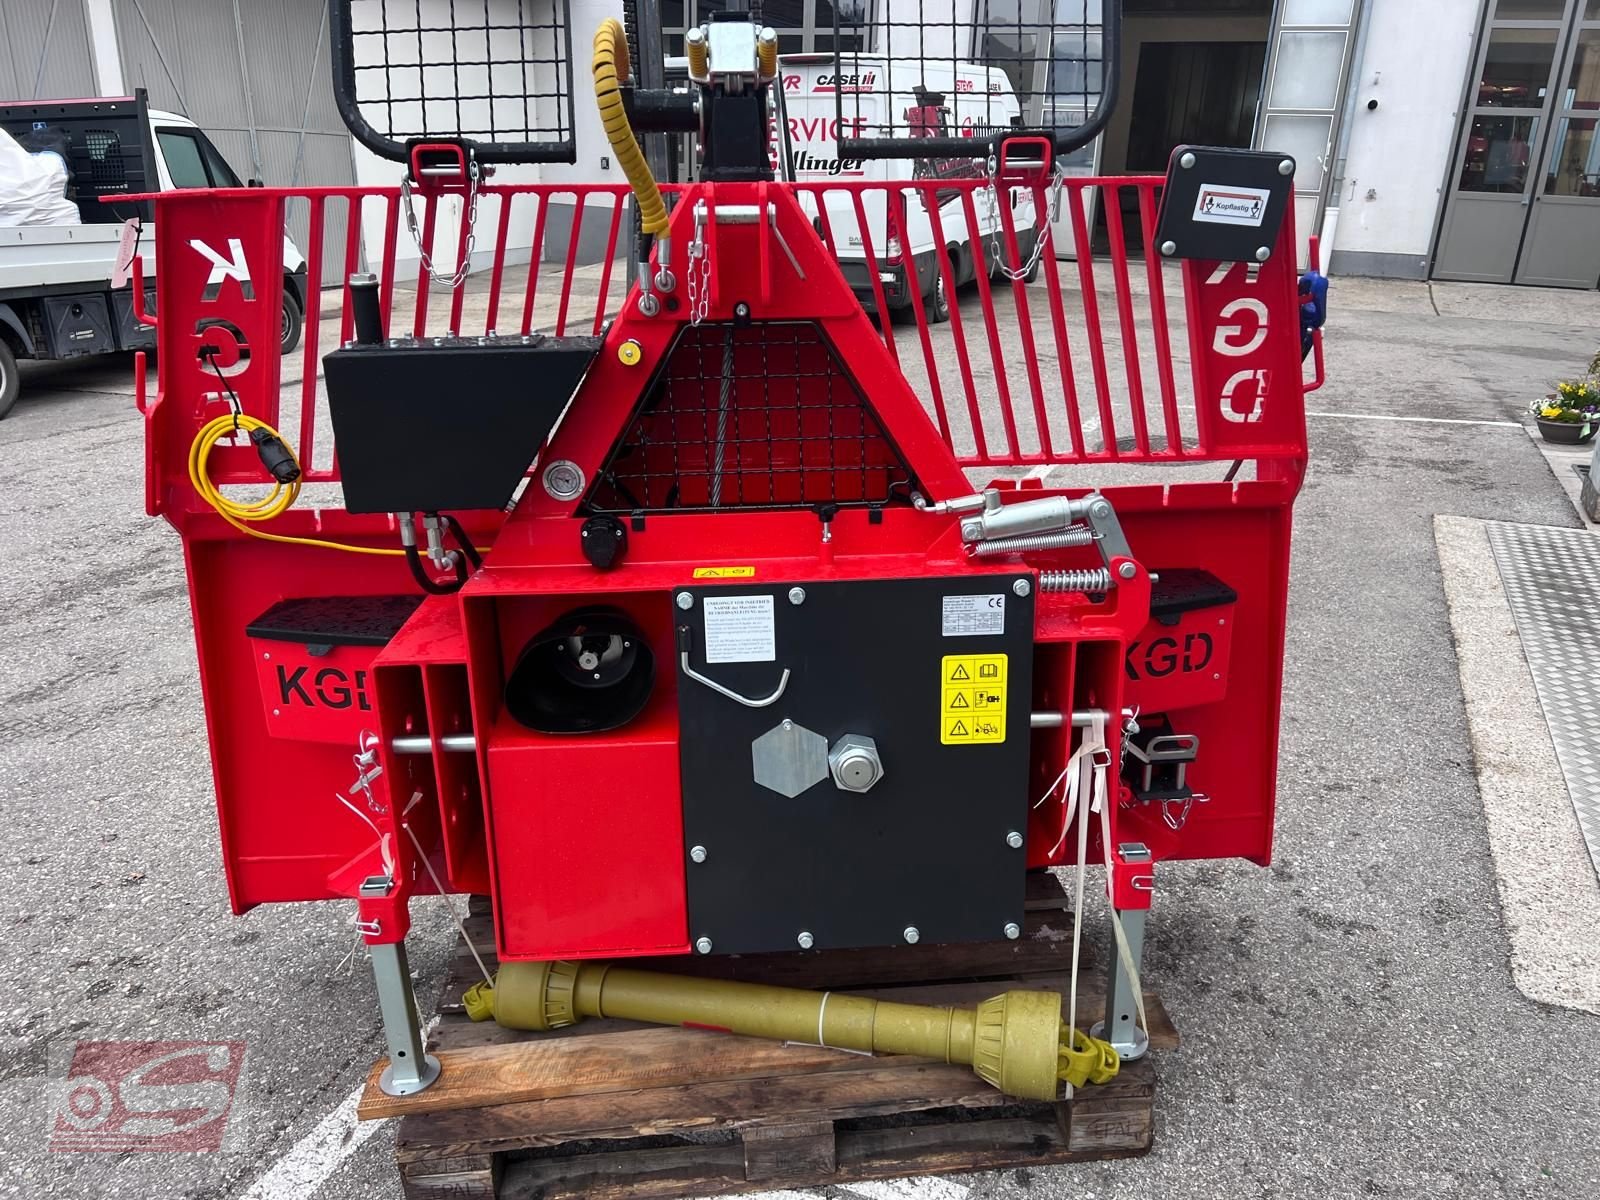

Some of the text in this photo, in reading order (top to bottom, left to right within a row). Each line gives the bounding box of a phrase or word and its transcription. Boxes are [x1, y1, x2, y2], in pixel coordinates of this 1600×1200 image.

[816, 74, 860, 86] CASE
[769, 117, 867, 143] ERVICE
[1215, 201, 1250, 213] Kopflastig
